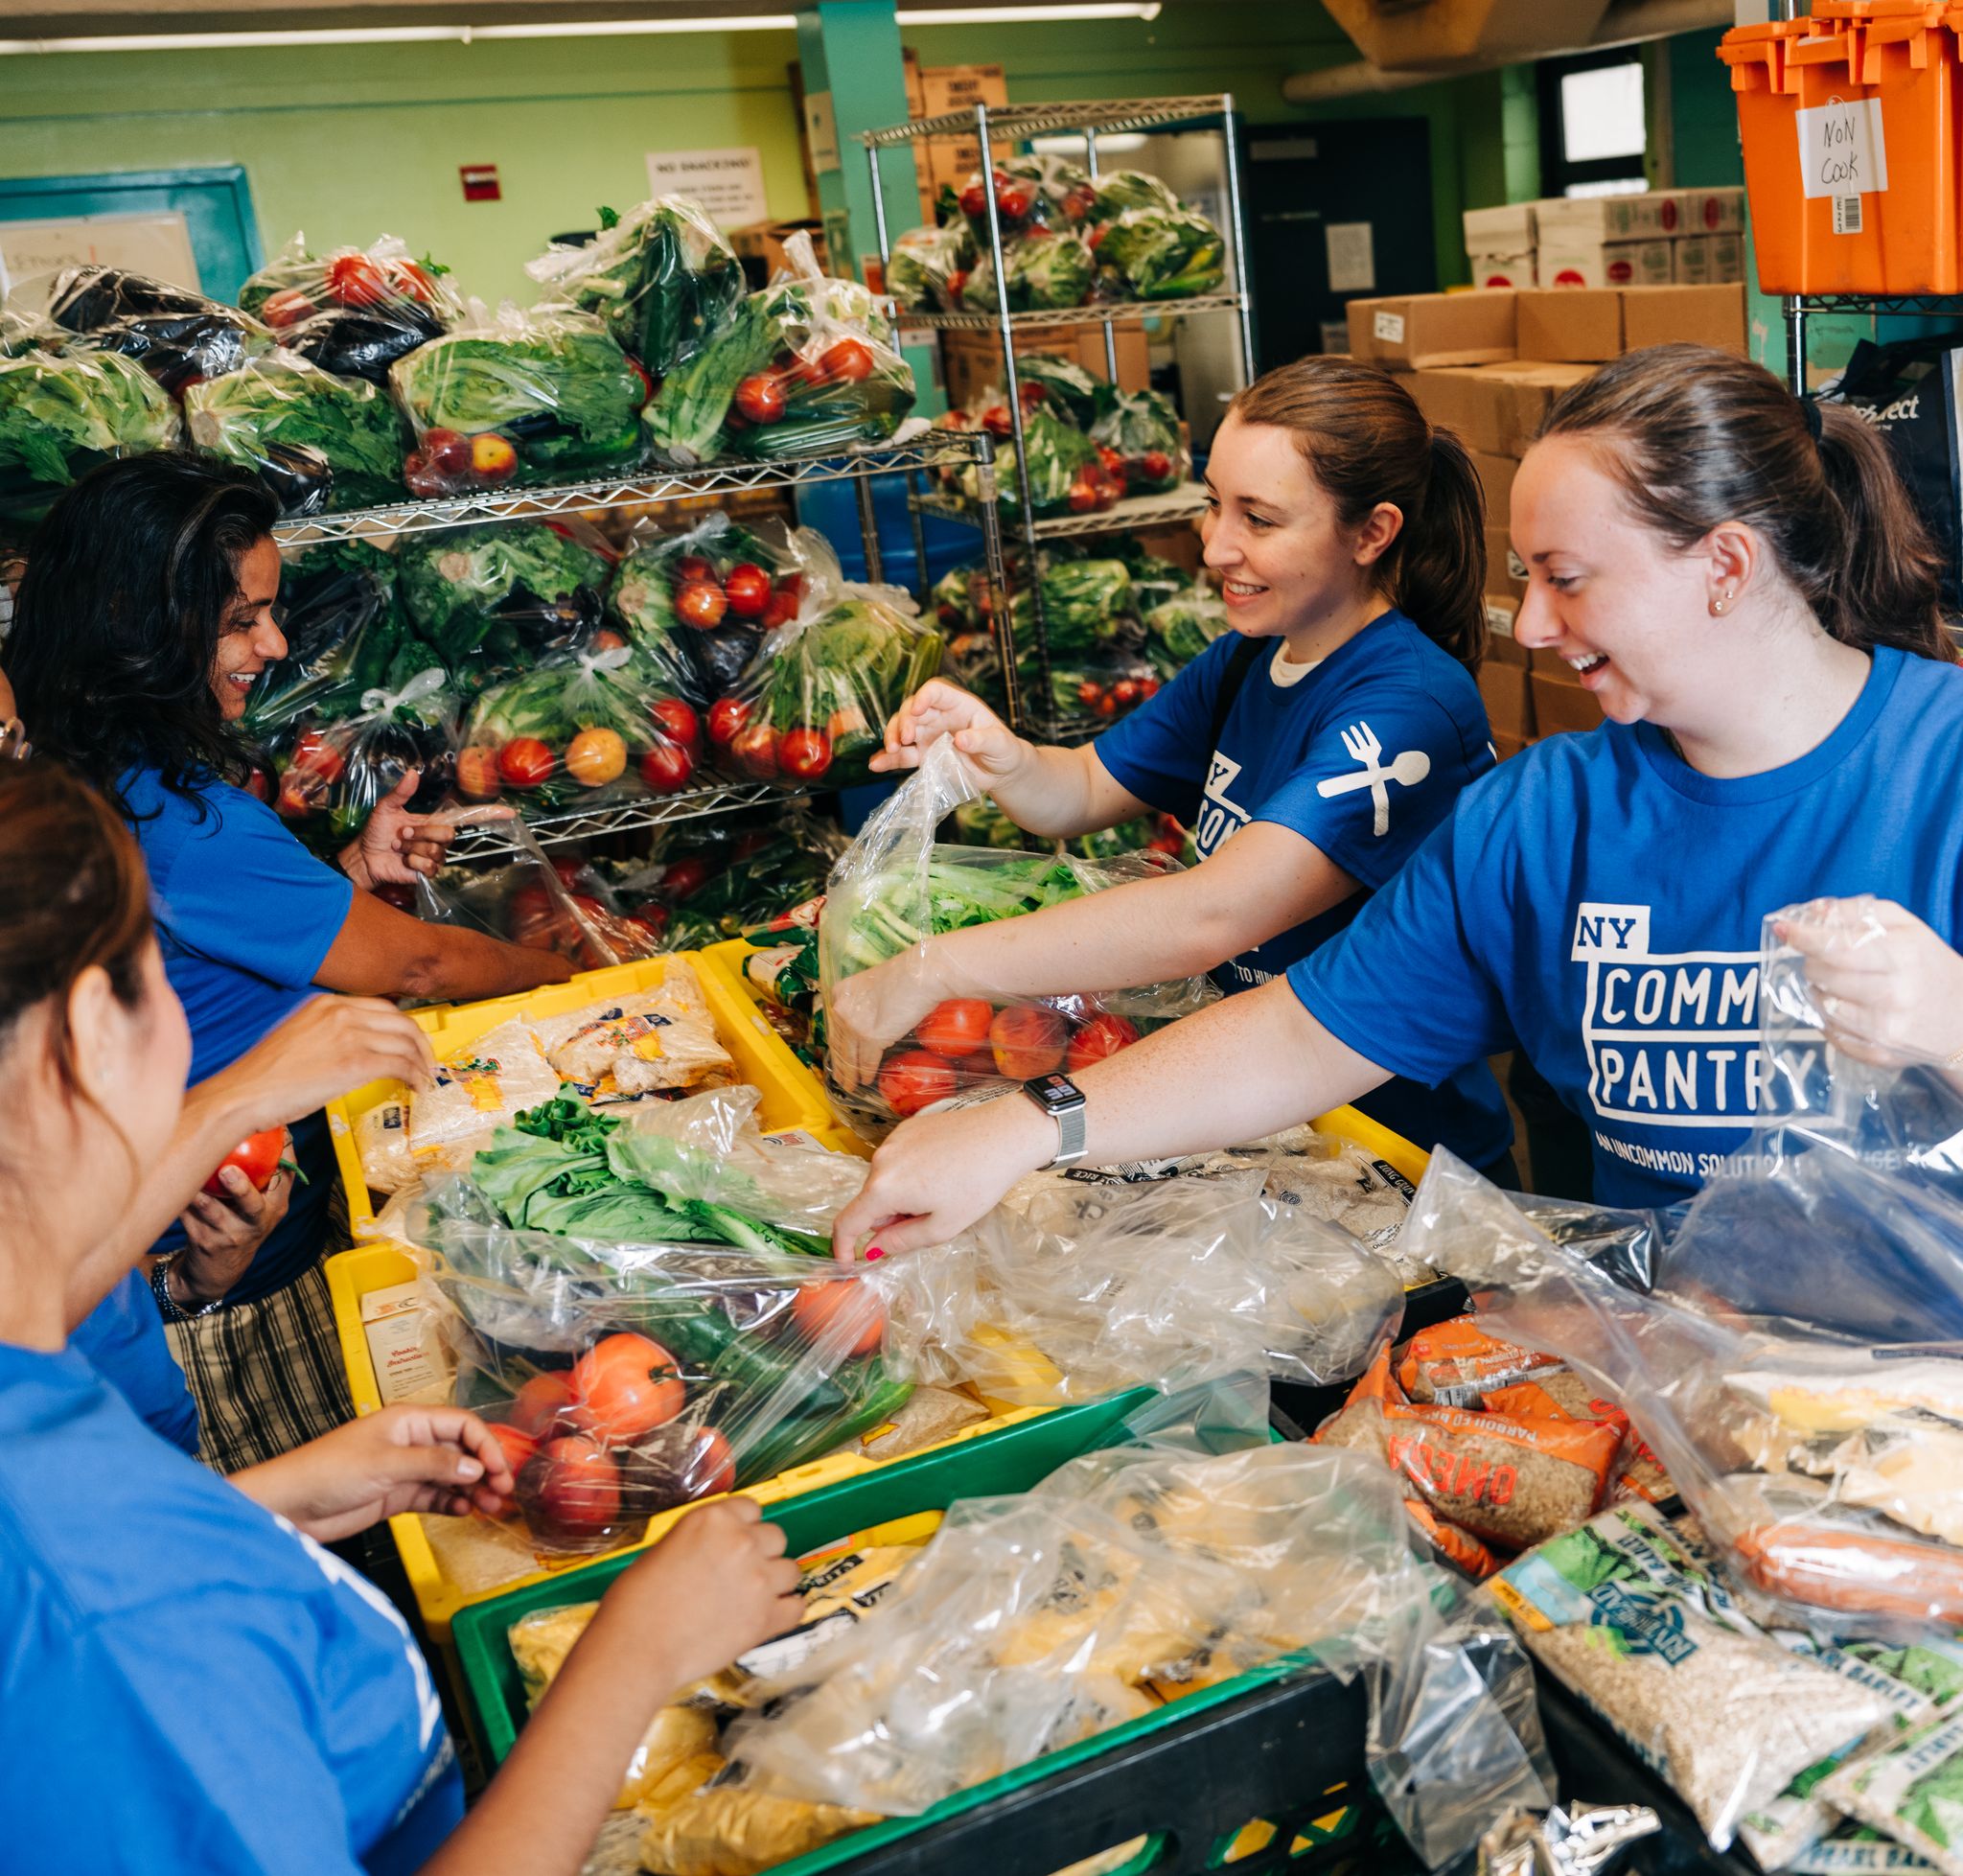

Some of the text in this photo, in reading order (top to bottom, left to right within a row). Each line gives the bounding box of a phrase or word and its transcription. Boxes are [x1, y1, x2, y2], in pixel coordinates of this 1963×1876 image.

[1577, 915, 1636, 949] NY
[1237, 965, 1253, 984] TO
[1601, 1048, 1817, 1111] PANTRY
[1613, 1139, 1696, 1175] UNCOMMON
[1073, 1170, 1101, 1181] RICE
[1377, 1163, 1398, 1182] LONG
